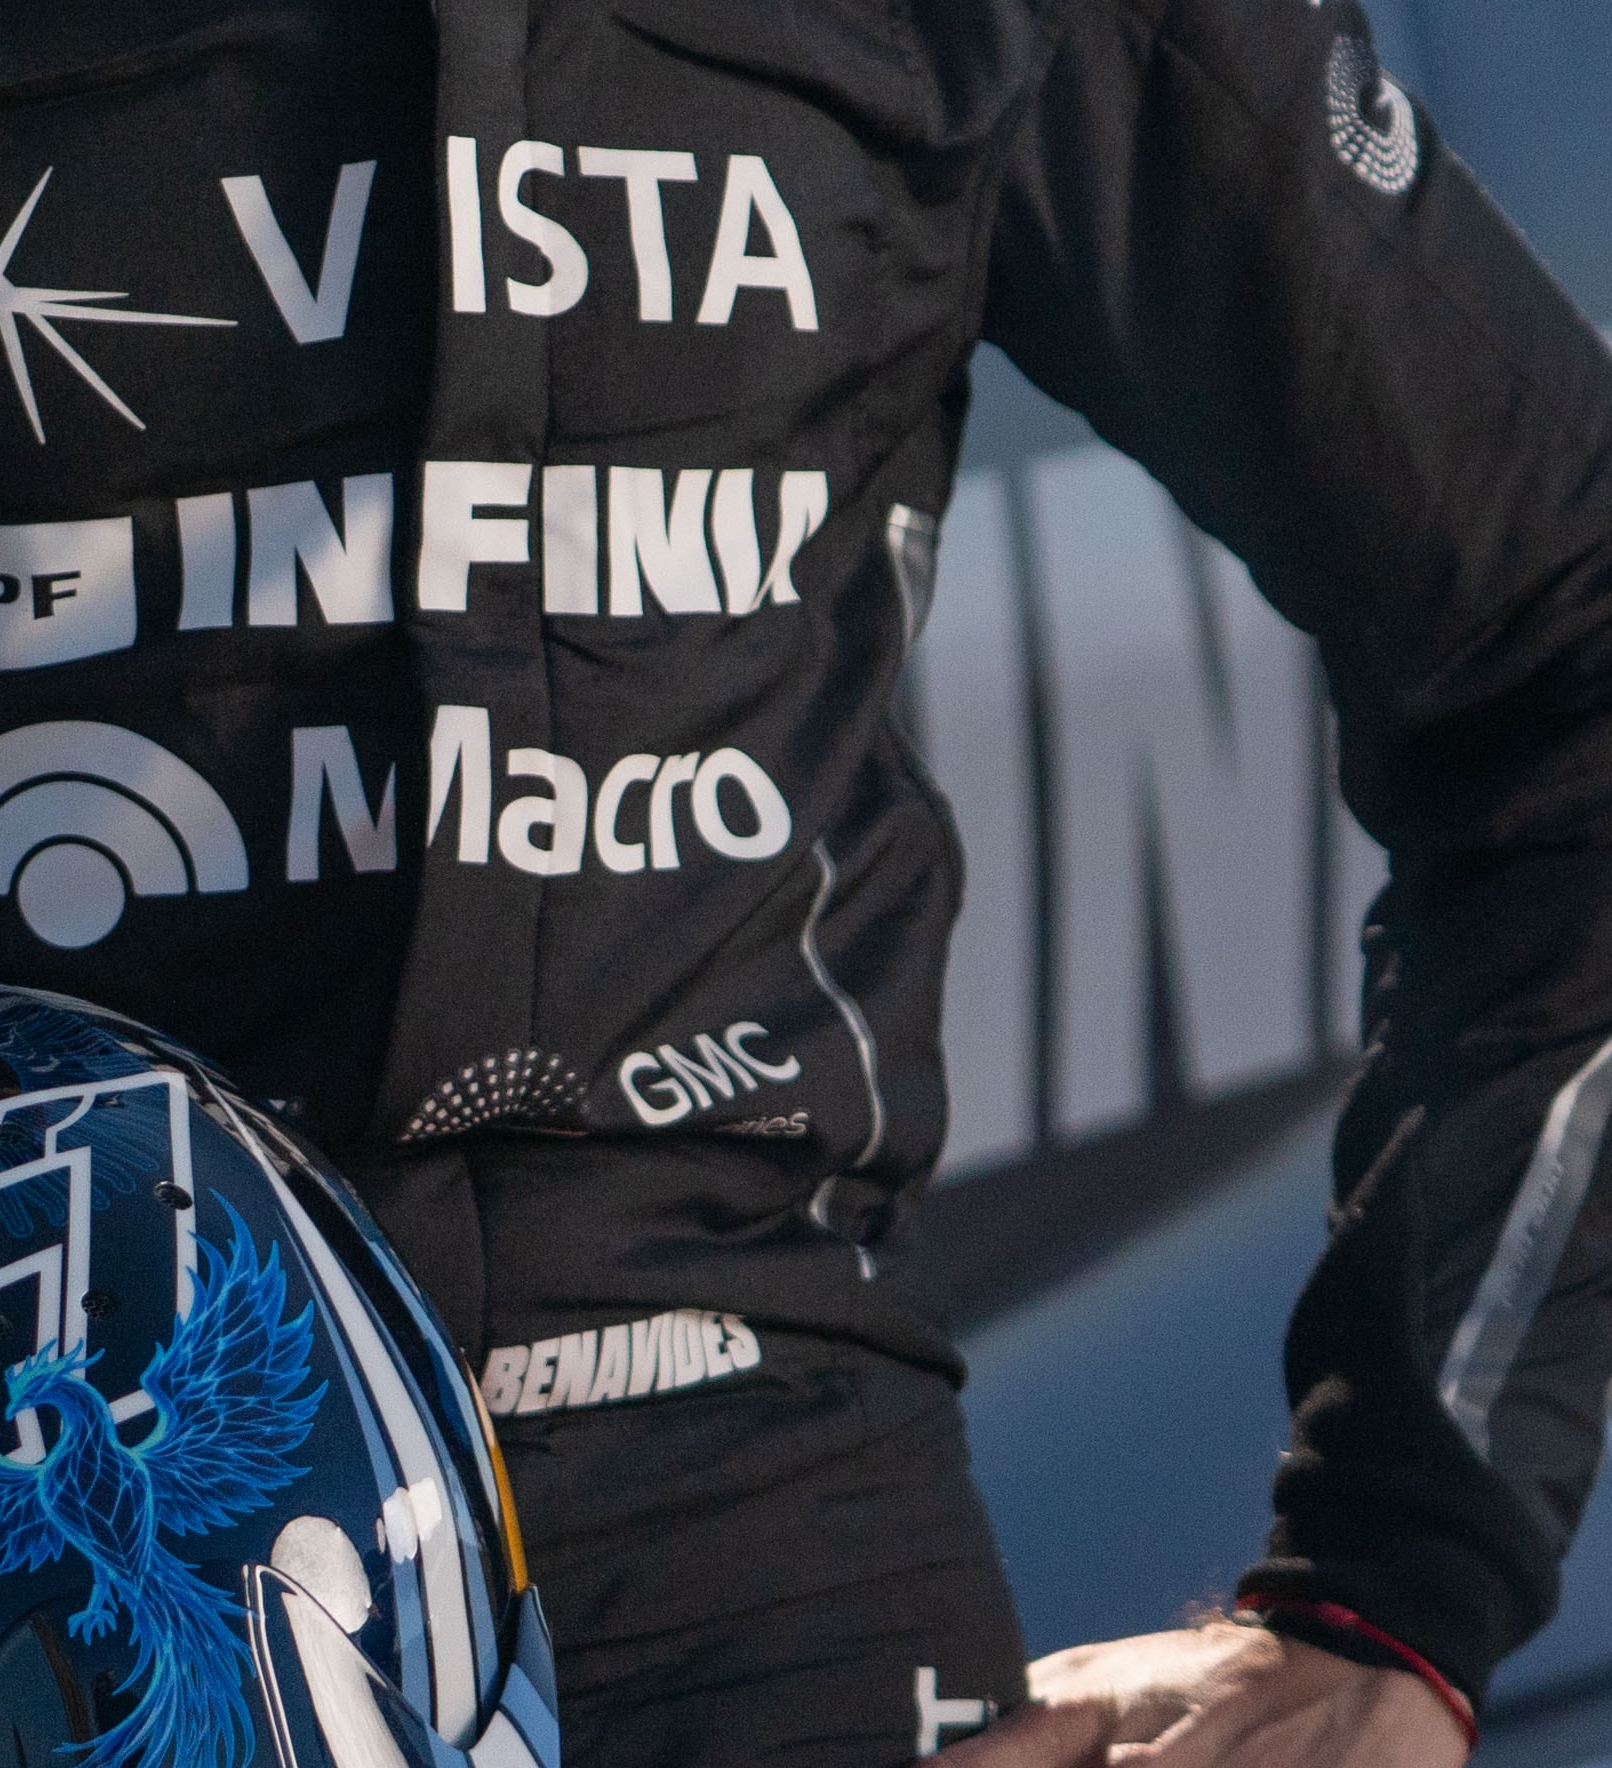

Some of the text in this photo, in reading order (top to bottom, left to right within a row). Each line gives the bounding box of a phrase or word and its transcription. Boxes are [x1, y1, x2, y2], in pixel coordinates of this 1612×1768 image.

[221, 135, 819, 345] VISTA
[285, 704, 792, 882] Macro
[619, 1021, 802, 1127] GMC
[484, 1308, 763, 1420] BENAVIDES
